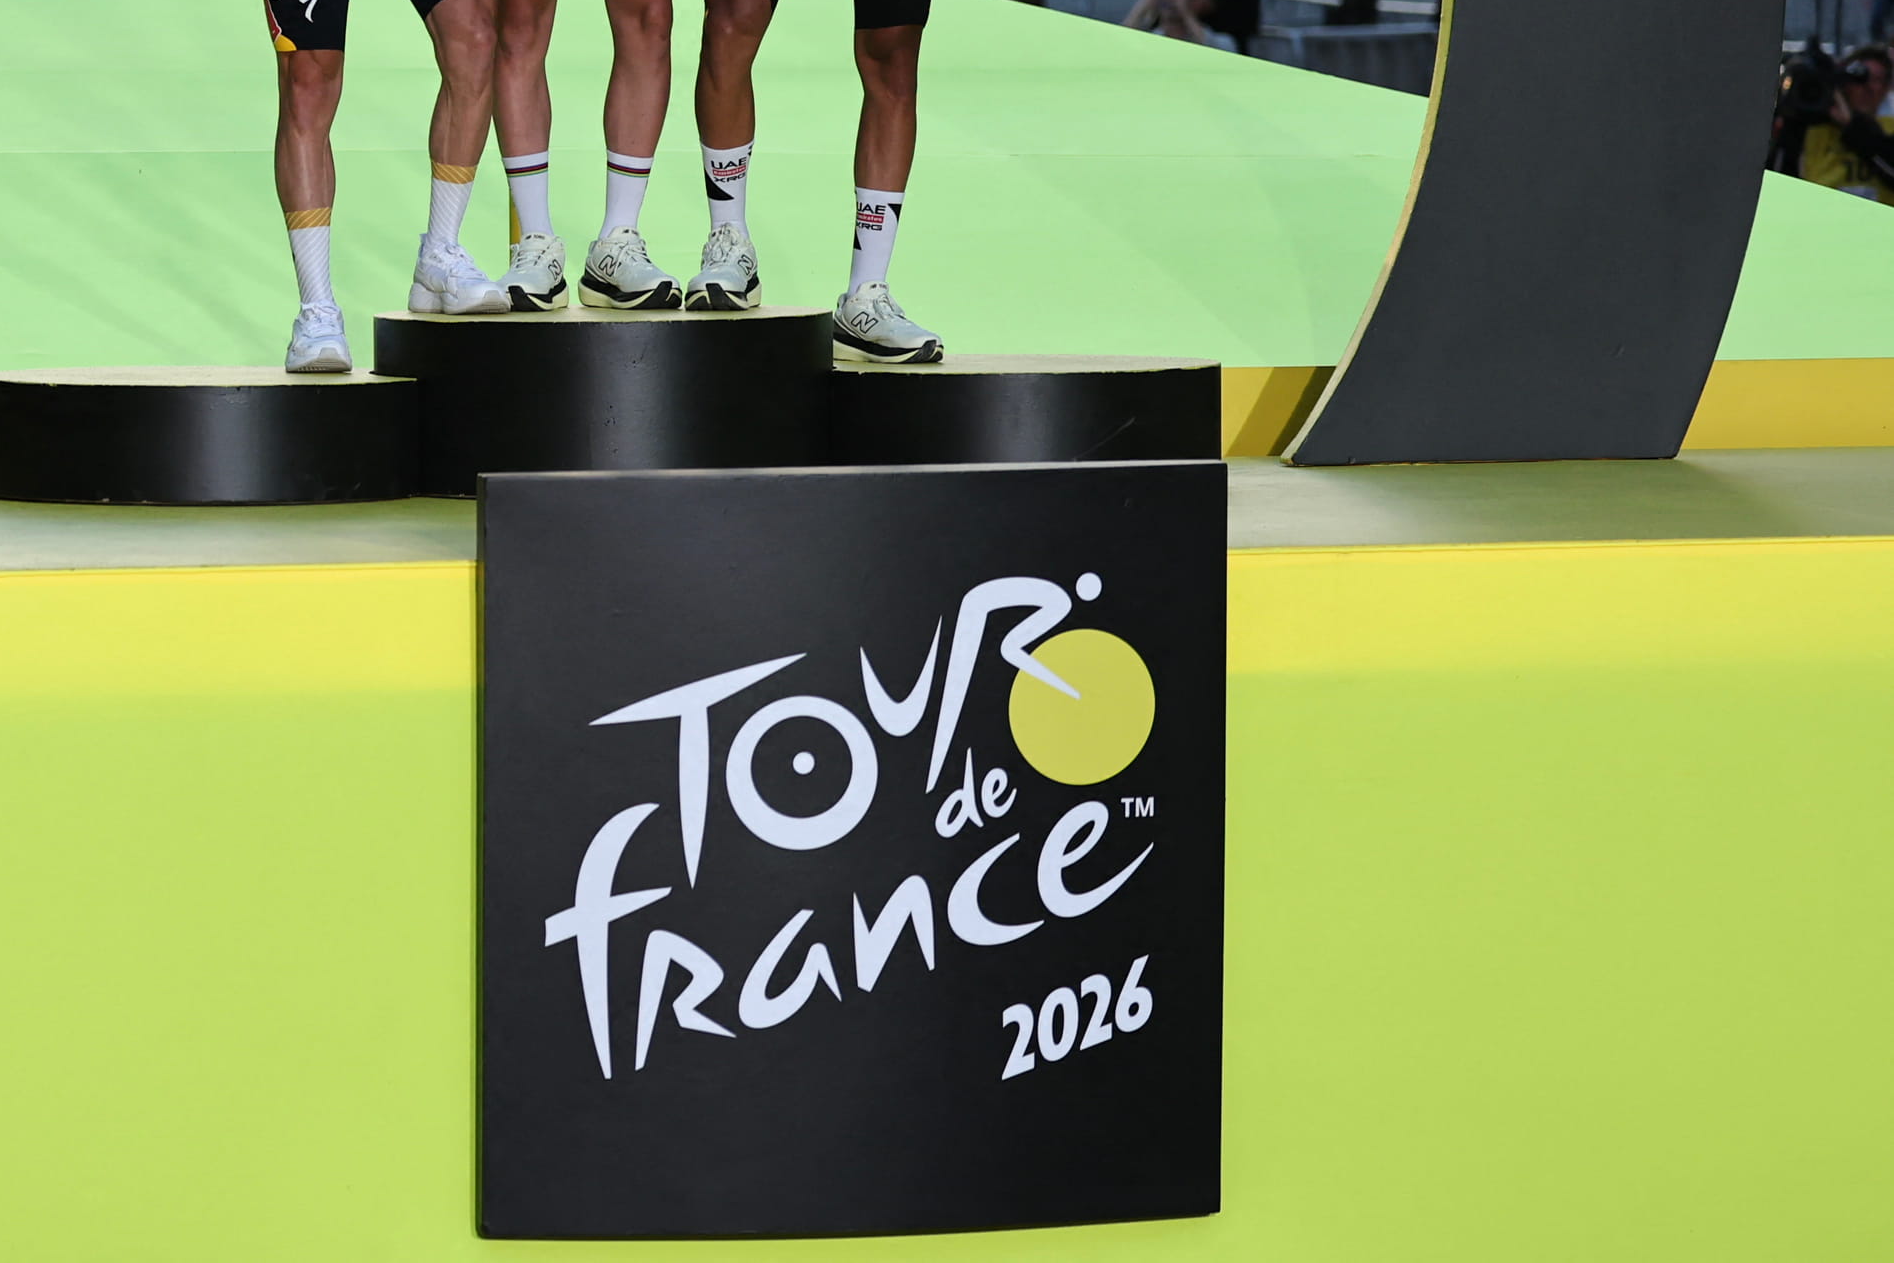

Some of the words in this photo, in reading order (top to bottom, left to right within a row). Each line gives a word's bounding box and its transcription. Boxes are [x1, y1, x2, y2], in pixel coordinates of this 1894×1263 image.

[711, 157, 747, 169] UAE
[589, 572, 1102, 889] TOUR
[935, 747, 1017, 839] de
[1001, 954, 1153, 1081] 2026
